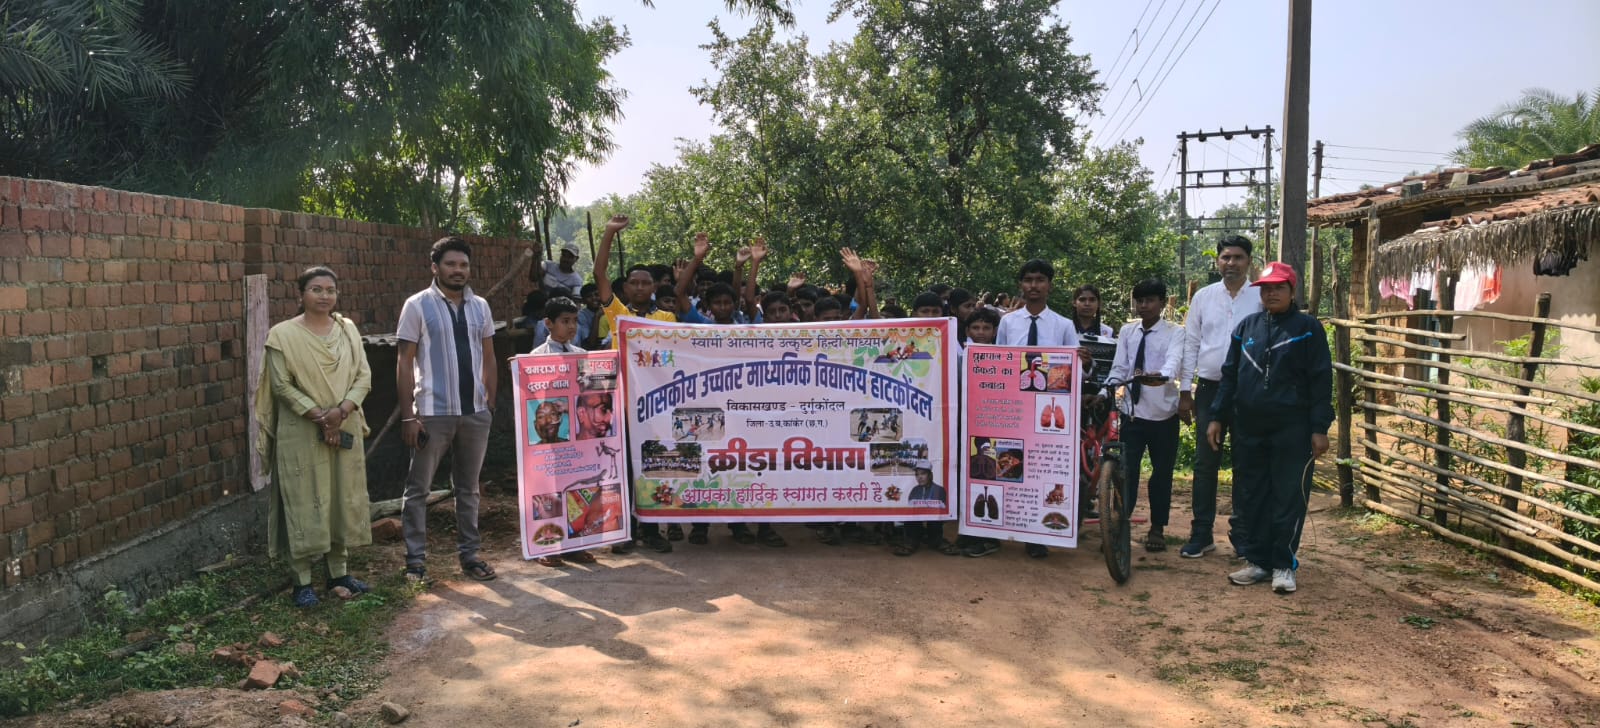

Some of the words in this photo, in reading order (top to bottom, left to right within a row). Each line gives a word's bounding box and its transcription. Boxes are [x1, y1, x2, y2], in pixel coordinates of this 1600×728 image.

[690, 335, 722, 348] स्वामी
[727, 335, 774, 349] आत्मानंद
[777, 337, 813, 351] उत्कृष्ट
[816, 335, 843, 348] हिन्दी
[847, 337, 881, 347] माध्यम
[637, 370, 697, 423] शासकीय
[700, 363, 744, 397] उच्चतर
[745, 351, 812, 388] माध्यमिक
[814, 353, 867, 395] विद्यालय
[869, 373, 933, 421] हाटकोंदल
[727, 399, 787, 411] विकासखण्ड
[707, 437, 778, 477] क्रीड़ा
[781, 436, 867, 471] विभाग
[682, 488, 732, 504] आपका
[735, 483, 778, 504] हार्दिक
[783, 487, 827, 502] स्वागत
[831, 483, 868, 503] करती
[870, 482, 883, 504] है
